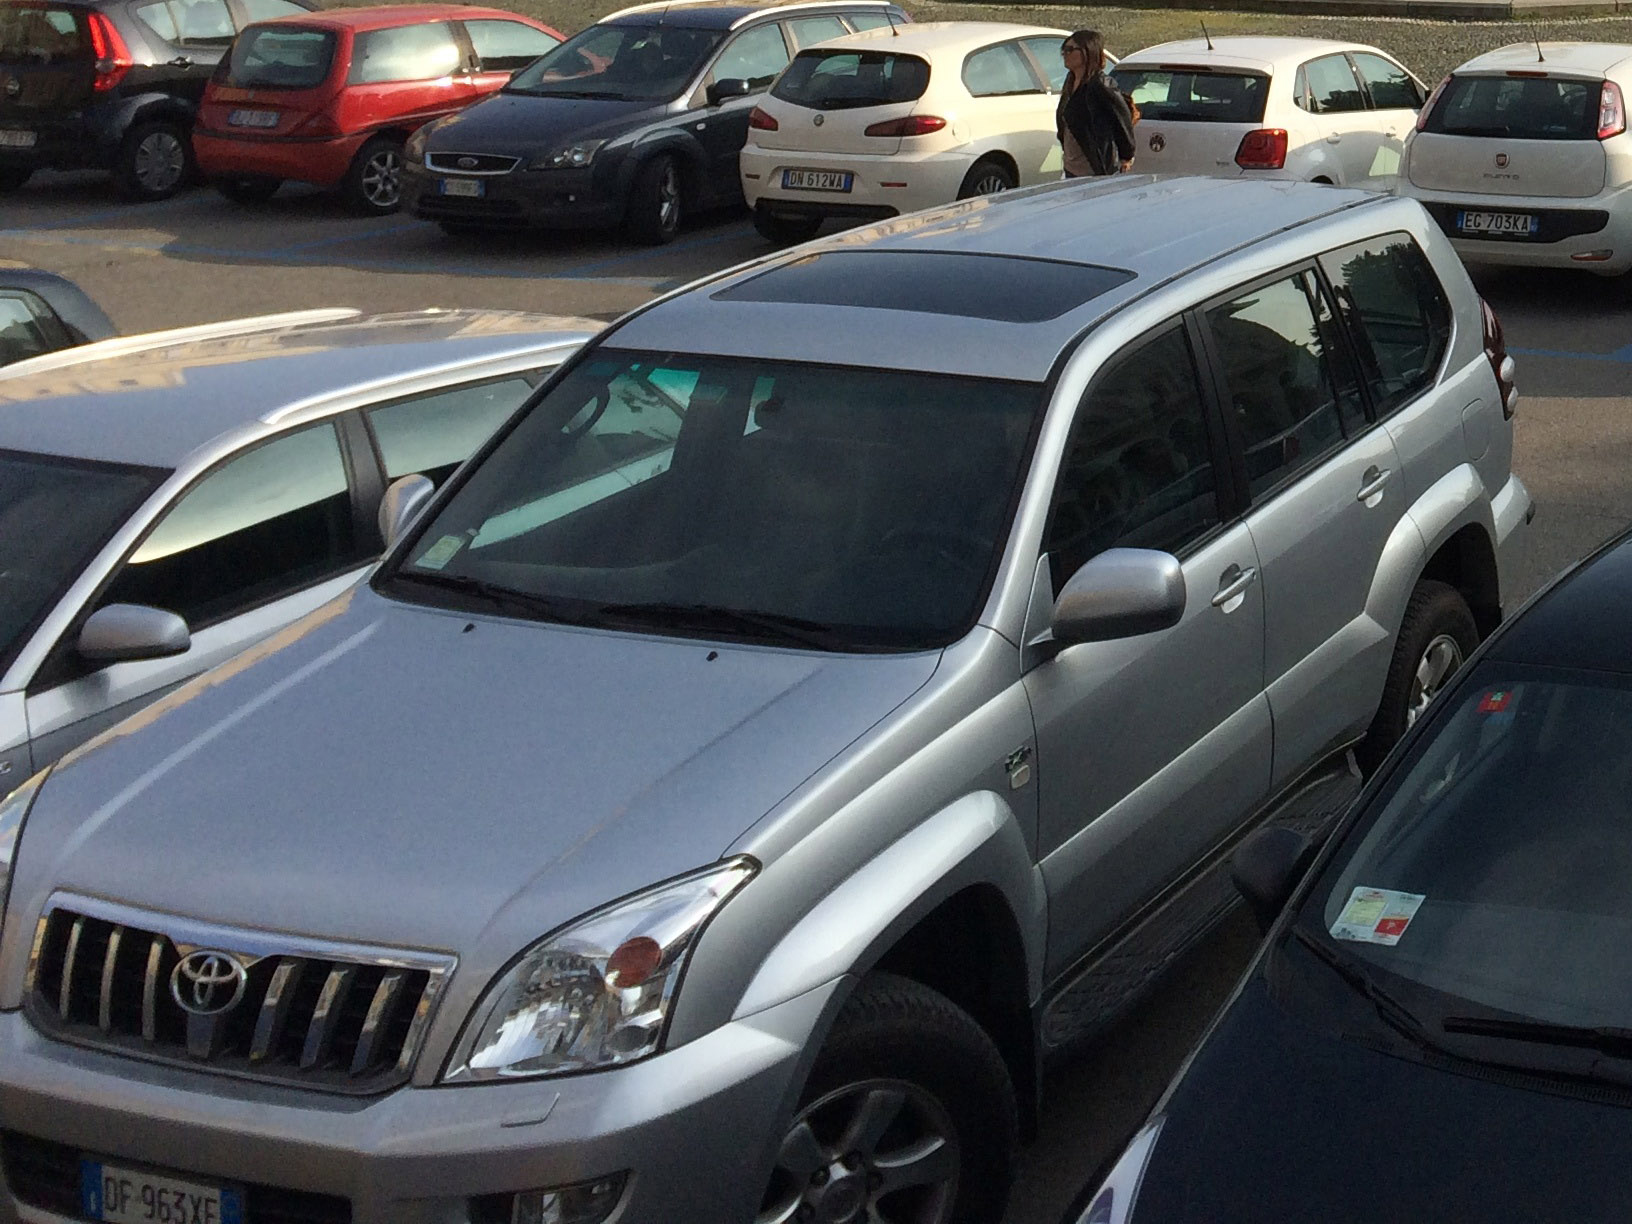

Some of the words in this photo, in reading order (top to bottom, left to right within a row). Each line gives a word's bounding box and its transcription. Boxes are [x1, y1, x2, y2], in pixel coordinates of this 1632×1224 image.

[790, 172, 804, 186] DN
[1486, 214, 1529, 232] 703KA
[104, 1177, 132, 1215] DF
